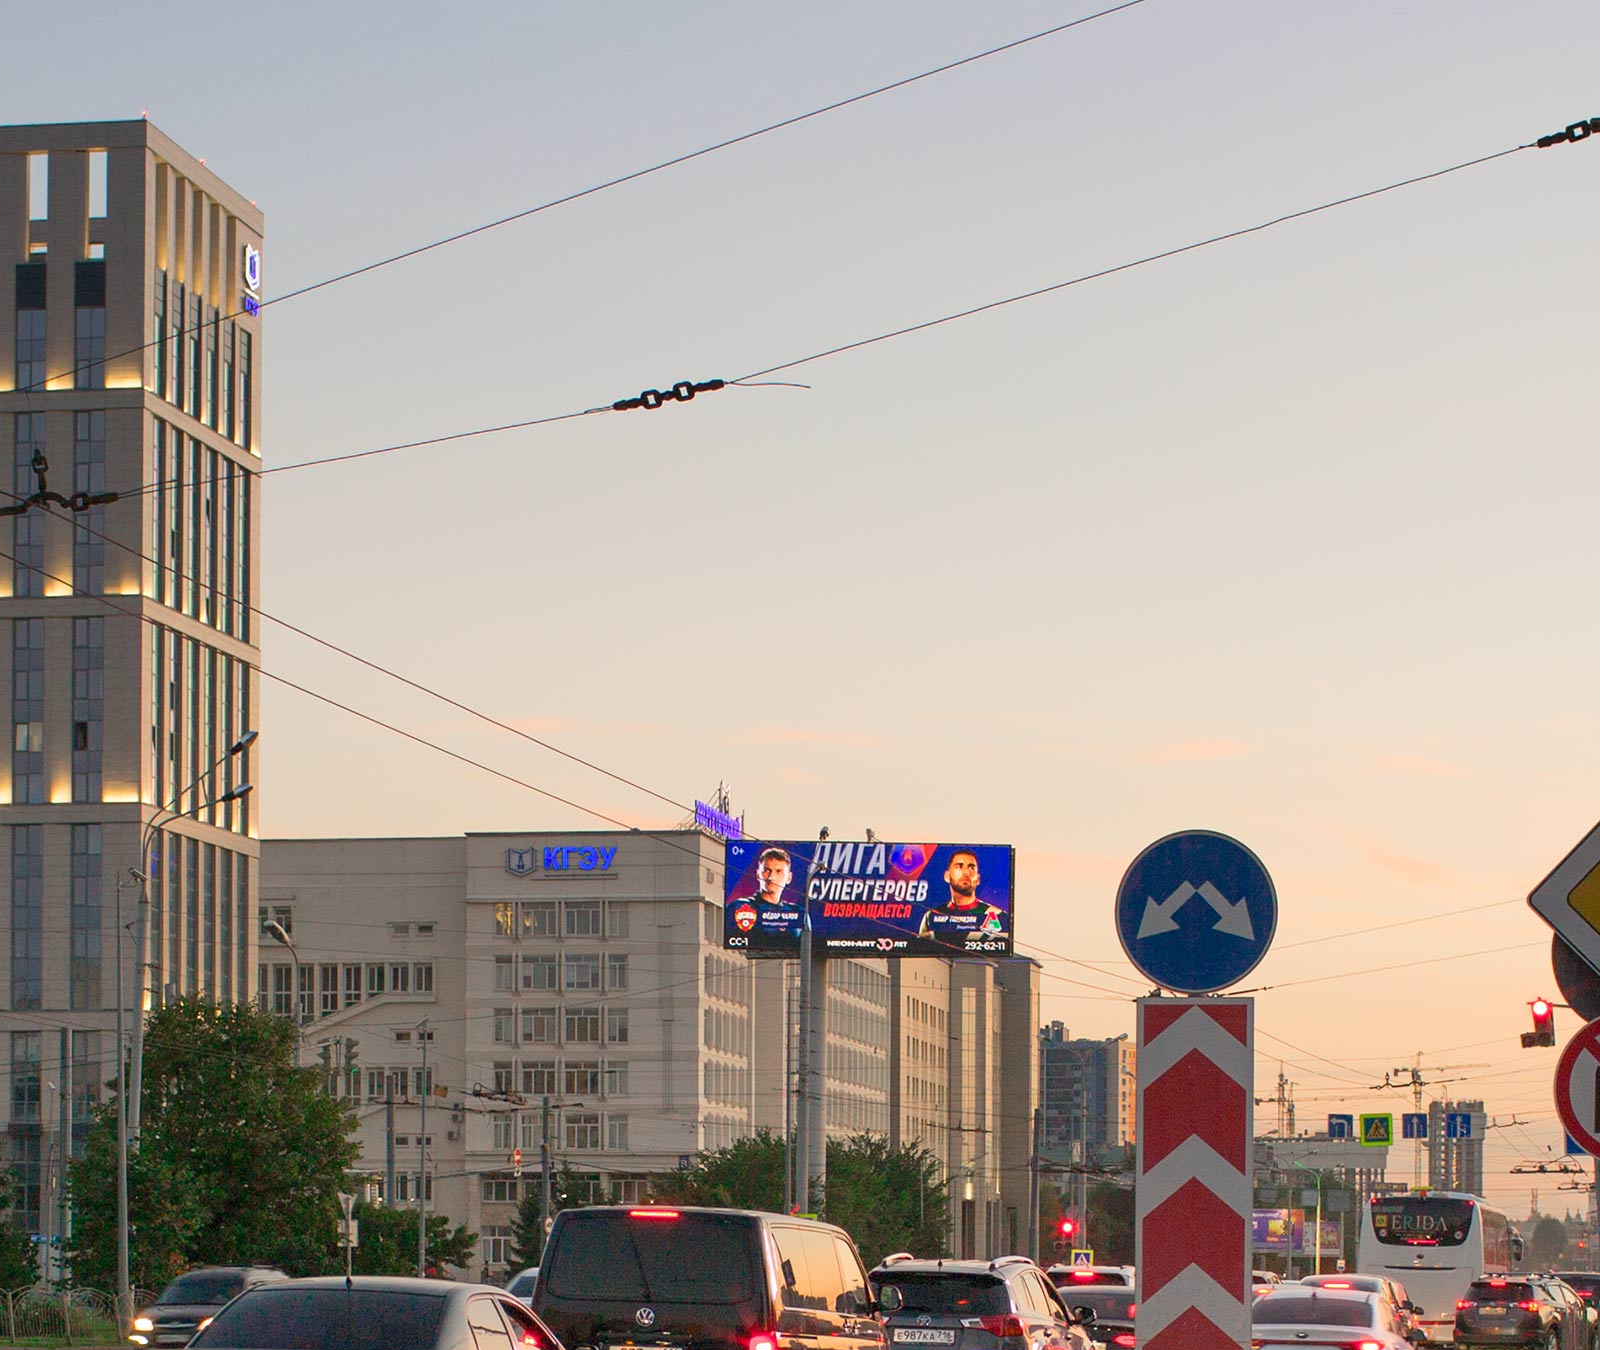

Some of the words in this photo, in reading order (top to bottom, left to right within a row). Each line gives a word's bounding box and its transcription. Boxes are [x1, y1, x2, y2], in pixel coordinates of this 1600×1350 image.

[543, 846, 617, 871] КГЭУ
[732, 846, 745, 856] 0+
[811, 843, 886, 876] ЛИГА
[808, 878, 928, 903] СУПЕРГЕРОЕВ
[823, 902, 912, 920] ВОЗВРАЩАЕТСЯ
[964, 941, 1006, 951] 292-62-11
[1391, 1214, 1448, 1232] ERIDA
[897, 1330, 935, 1341] Е987КА
